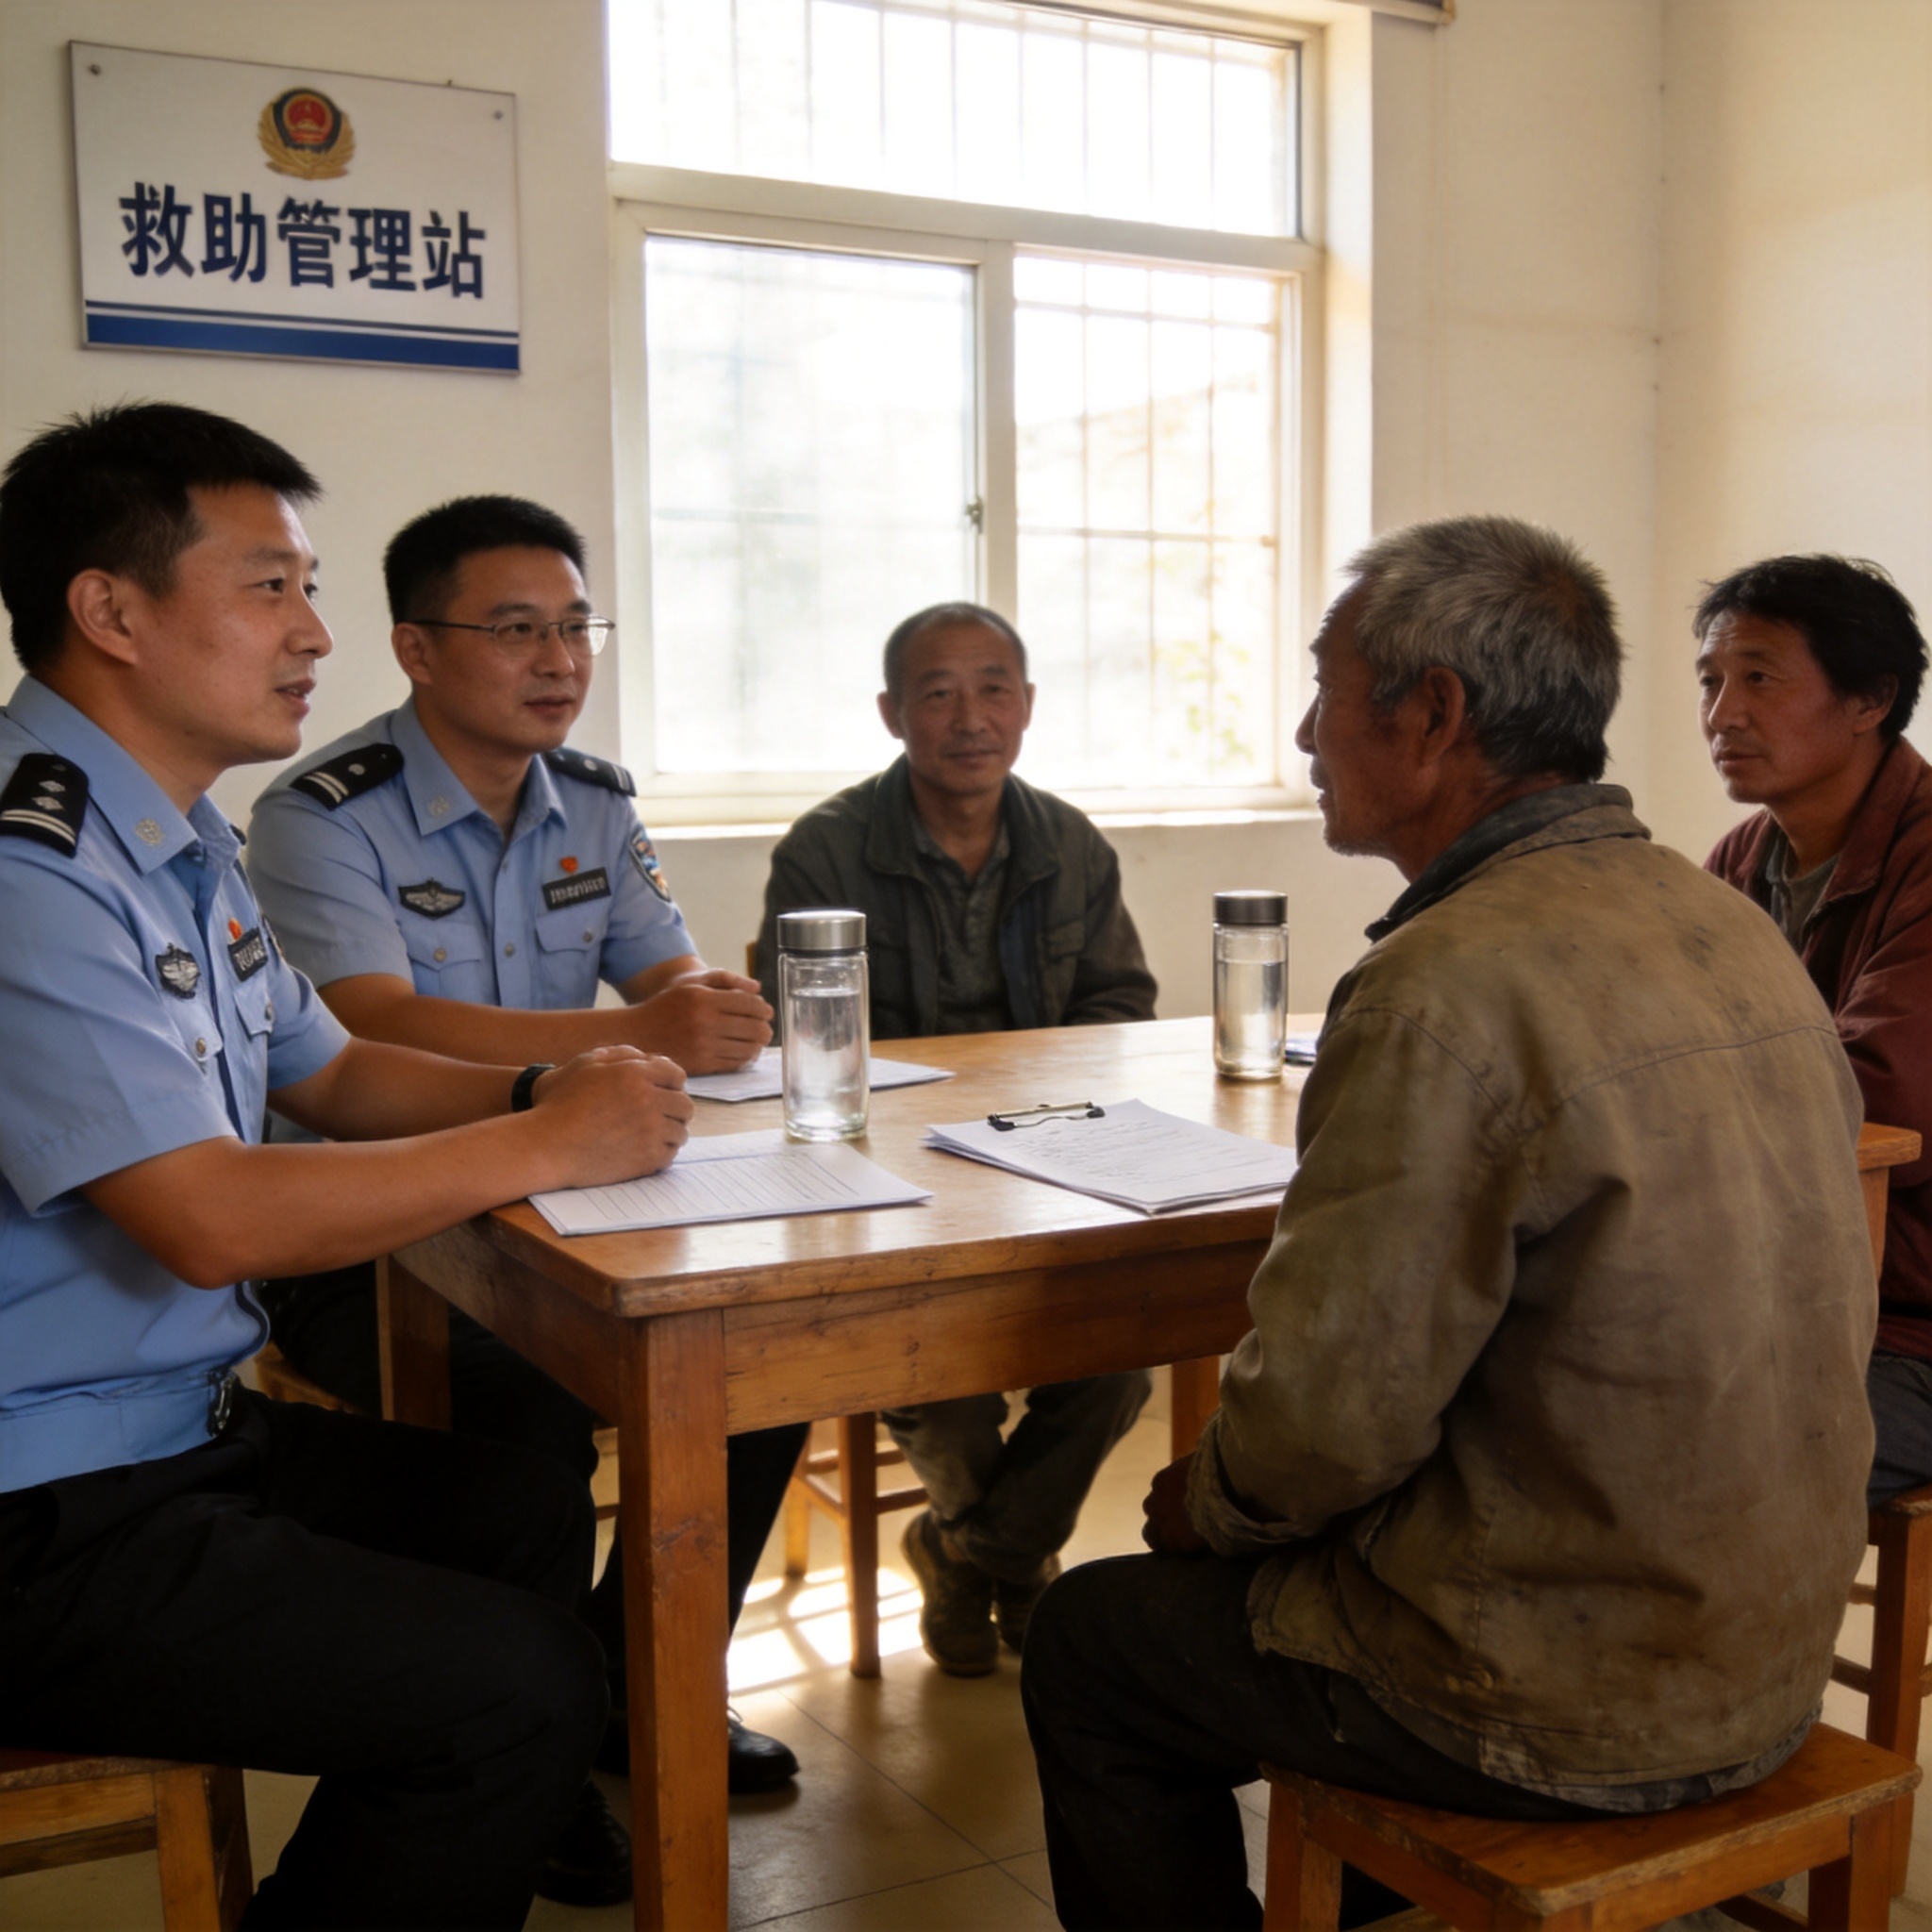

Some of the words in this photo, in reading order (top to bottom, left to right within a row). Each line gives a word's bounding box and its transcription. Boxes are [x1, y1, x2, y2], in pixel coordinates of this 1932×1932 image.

[119, 182, 486, 299] 救助管理站
